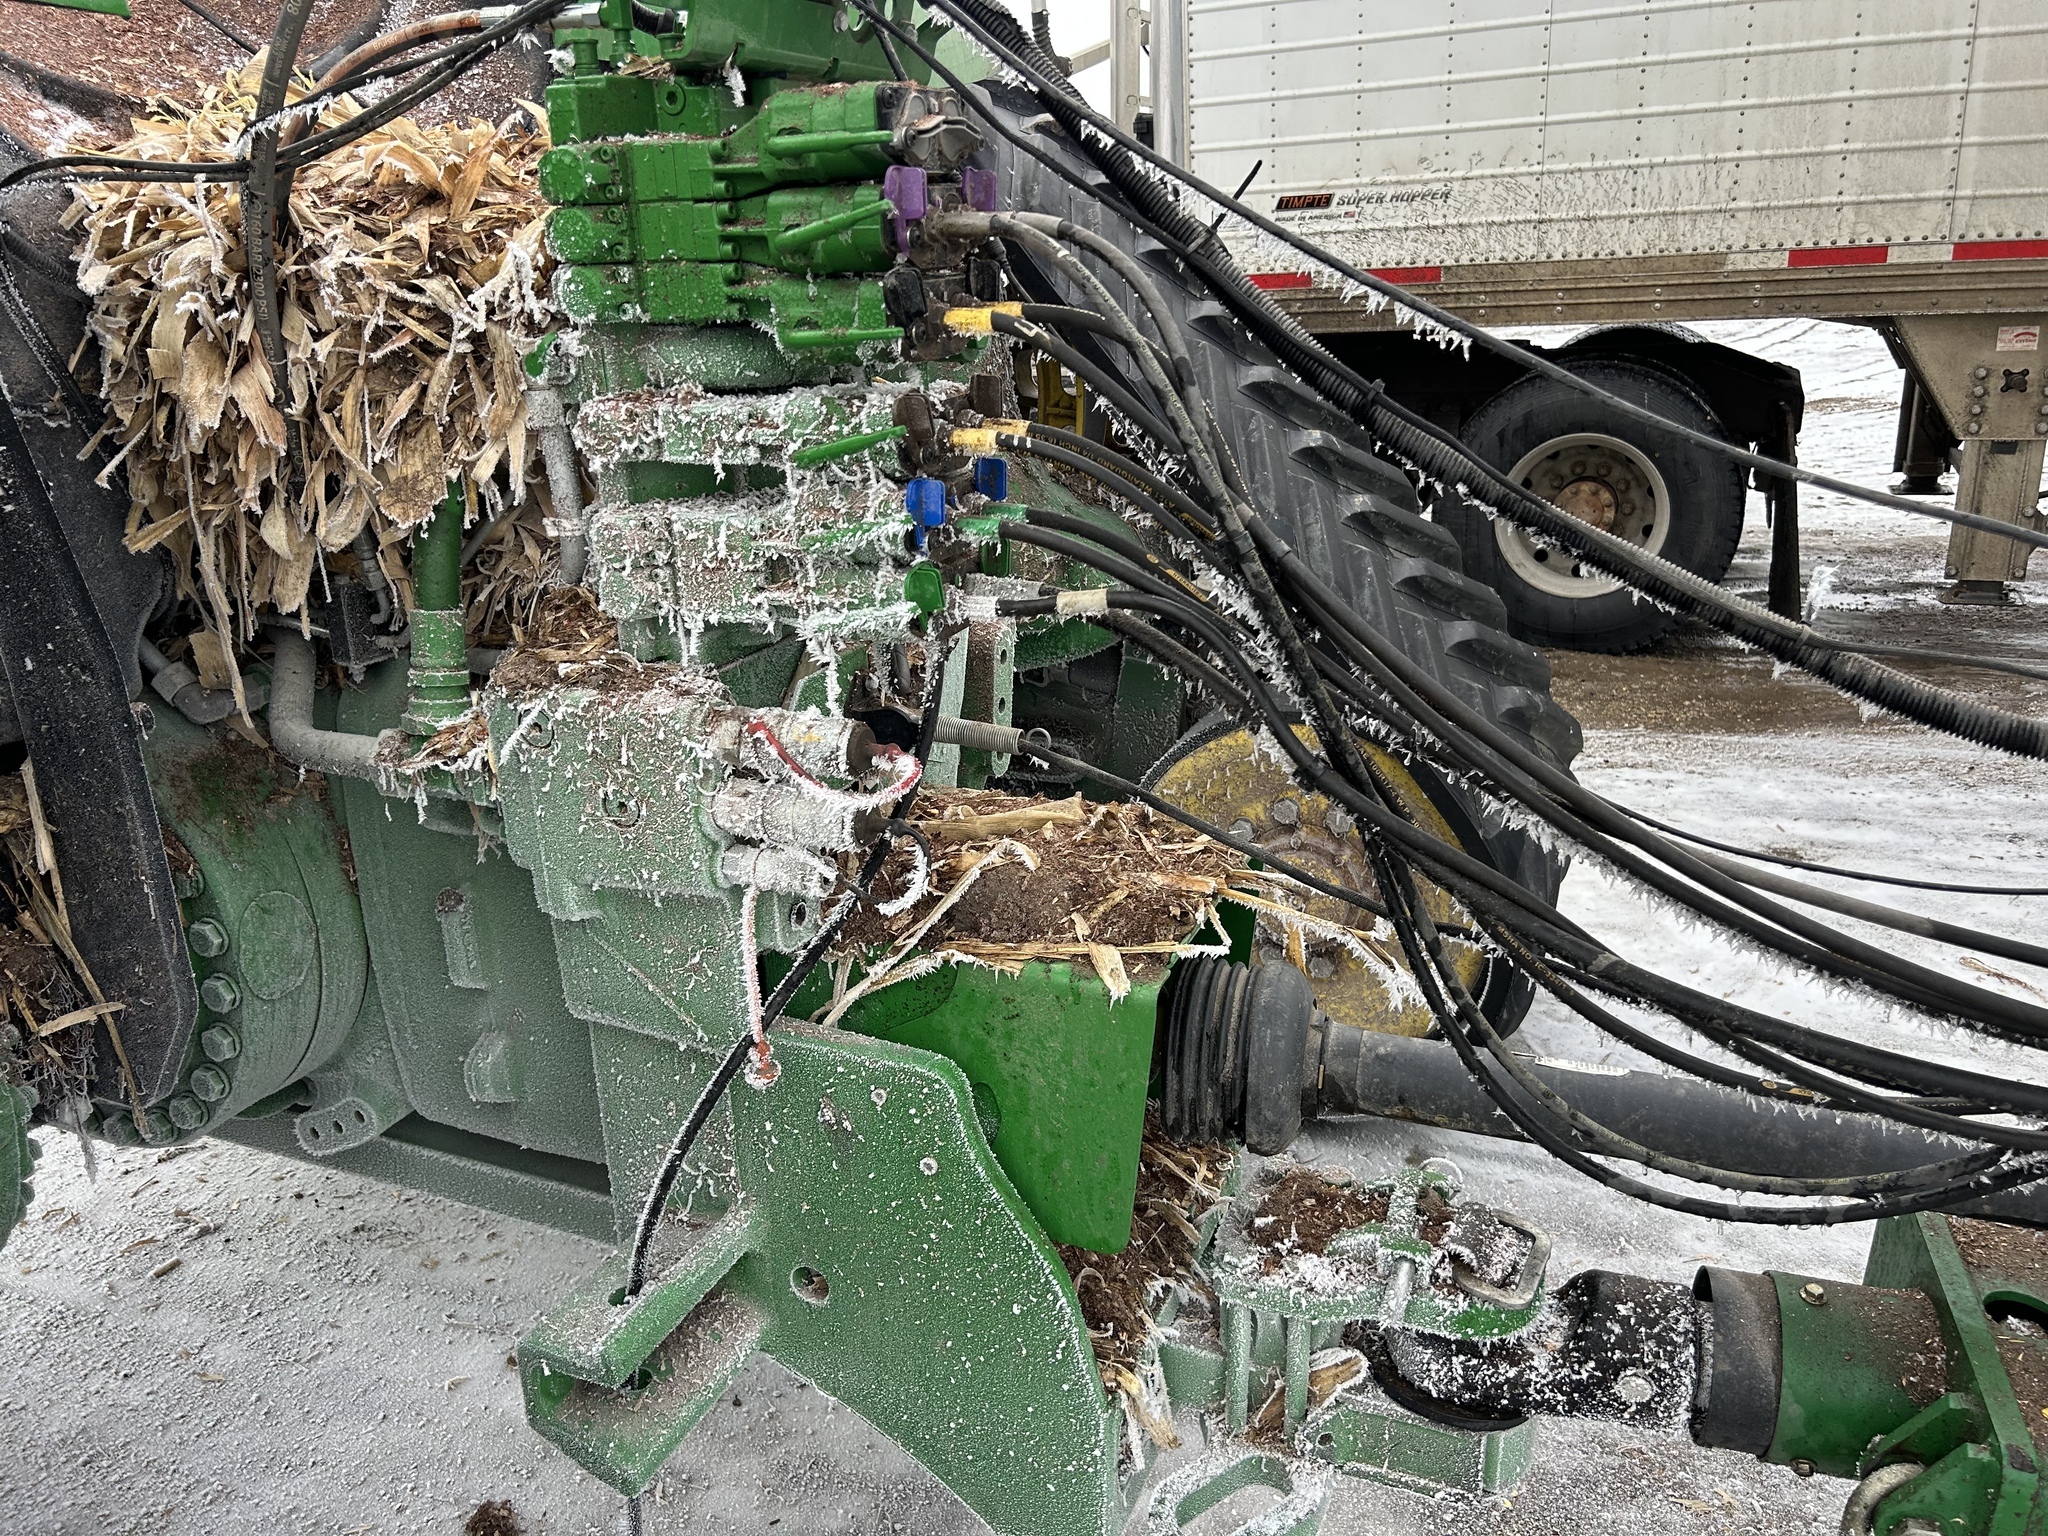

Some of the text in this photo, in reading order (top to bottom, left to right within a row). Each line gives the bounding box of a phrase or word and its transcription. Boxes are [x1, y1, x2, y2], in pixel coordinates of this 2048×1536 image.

[371, 33, 398, 50] Bruiser
[1280, 187, 1452, 209] TIMPTE SUPER HOPPER
[250, 214, 260, 234] 160
[250, 236, 262, 262] BAR
[251, 264, 265, 297] (2300
[255, 298, 269, 321] PSI)
[1116, 310, 1153, 359] RESISTANT
[1149, 358, 1172, 391] FLAME
[1058, 439, 1080, 453] INCH
[1095, 455, 1154, 495] WEARGUARD
[1367, 760, 1398, 797] 100R17-4
[1394, 795, 1413, 817] W.P.
[1495, 924, 1520, 948] MSHA
[1518, 946, 1535, 963] NO.
